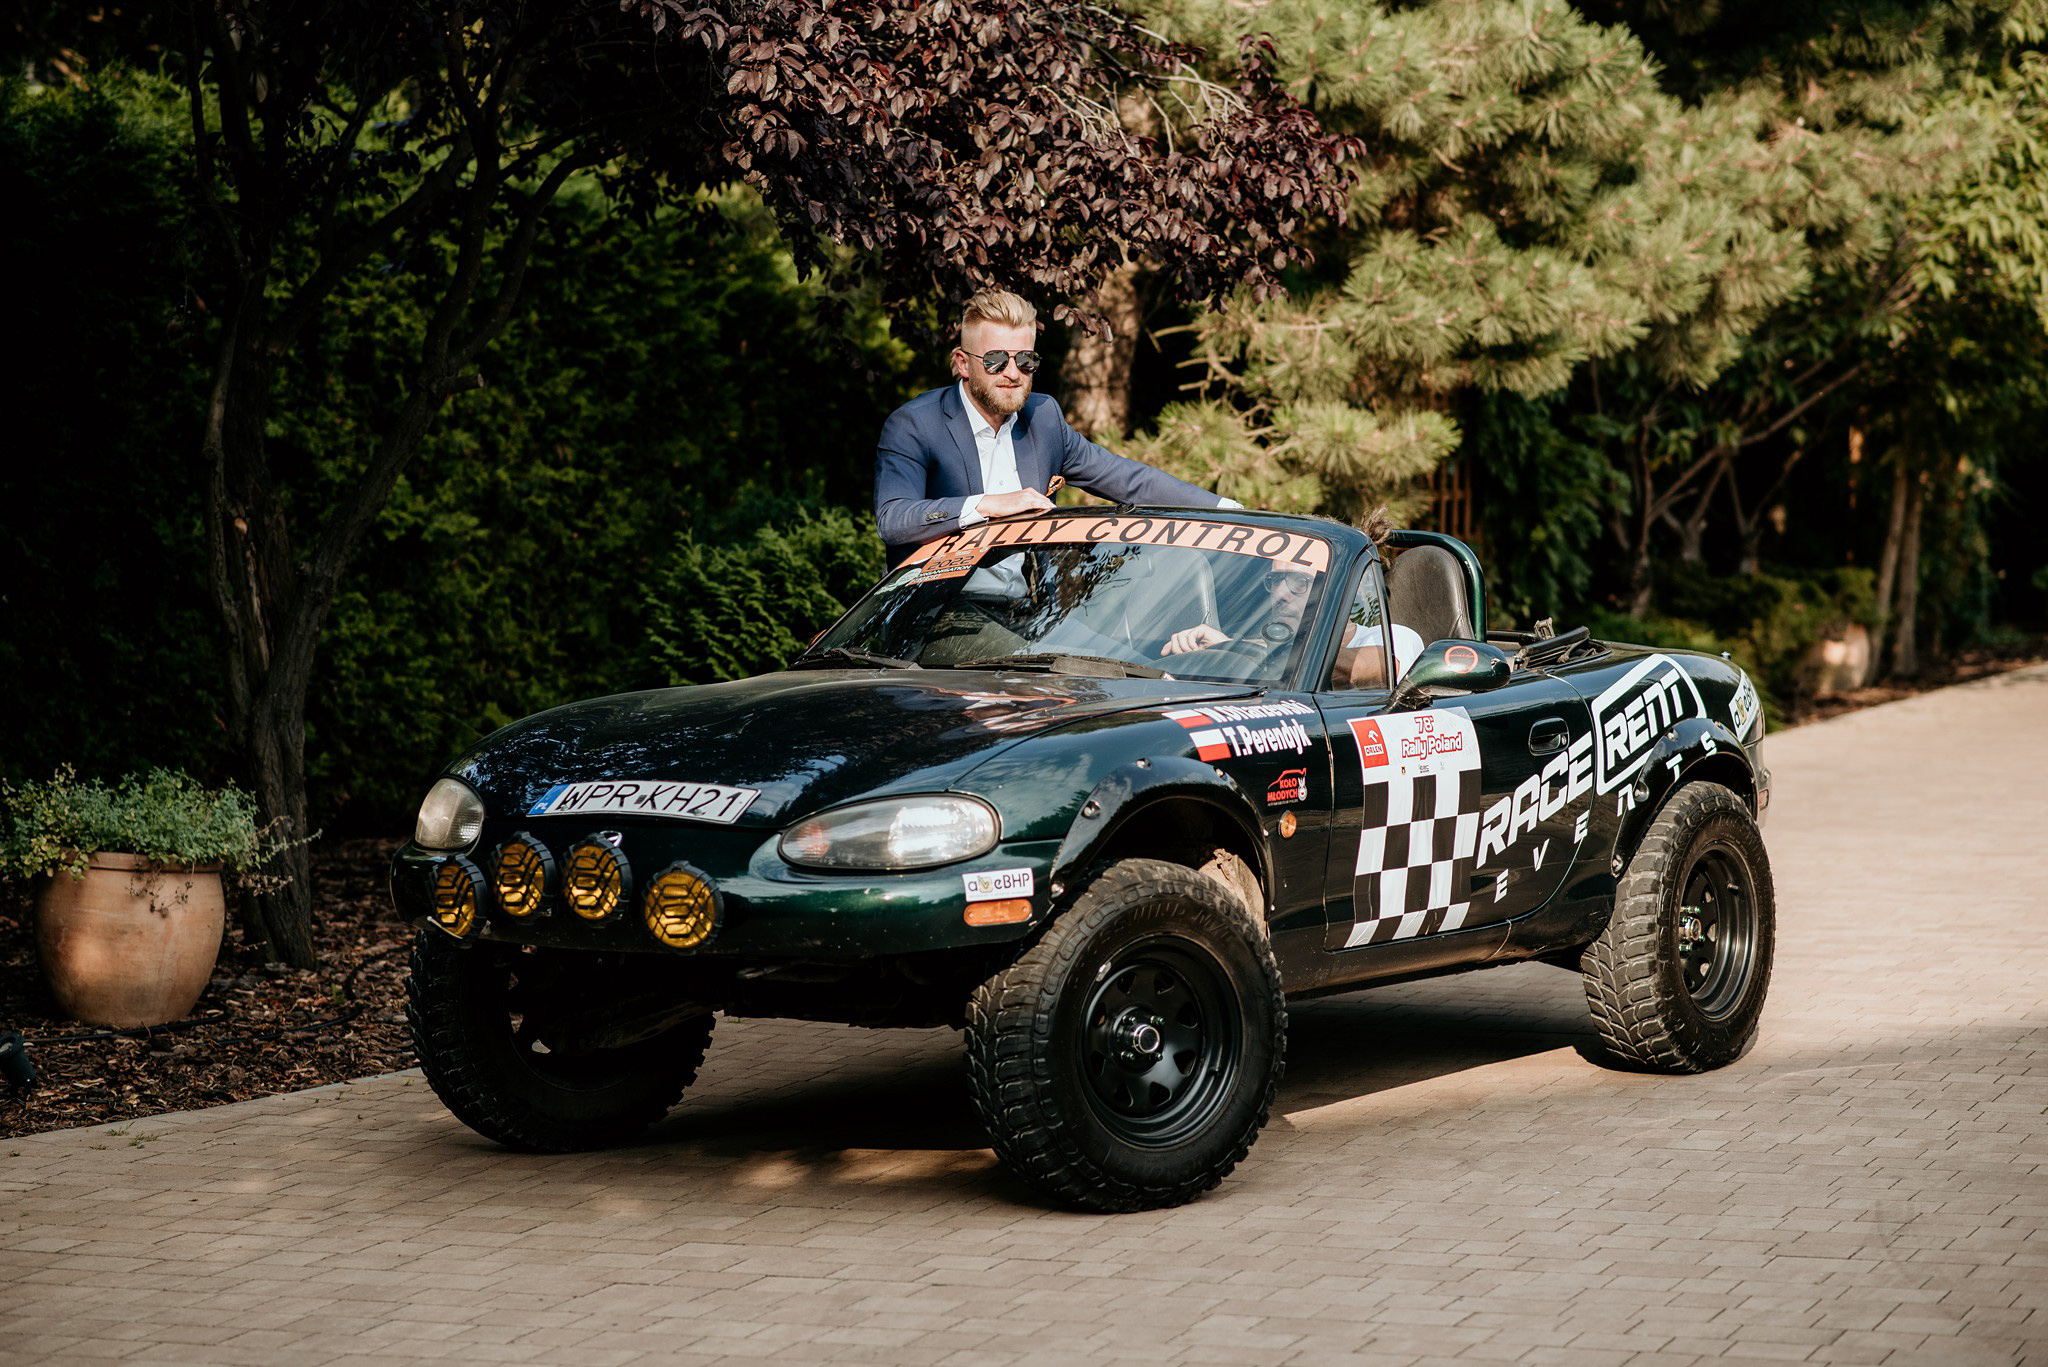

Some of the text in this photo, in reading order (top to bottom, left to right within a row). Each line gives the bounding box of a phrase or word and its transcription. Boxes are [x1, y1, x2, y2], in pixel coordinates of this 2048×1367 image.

[931, 517, 1315, 567] RALLY CONTROL
[926, 555, 975, 571] 2022
[1604, 667, 1684, 771] RENT
[1222, 718, 1313, 757] T.Perendyk
[1365, 745, 1383, 755] ORLEN
[1401, 731, 1463, 760] Rally Poland
[534, 802, 548, 811] PL
[555, 784, 744, 817] WPR KH21
[1476, 731, 1594, 869] RACE
